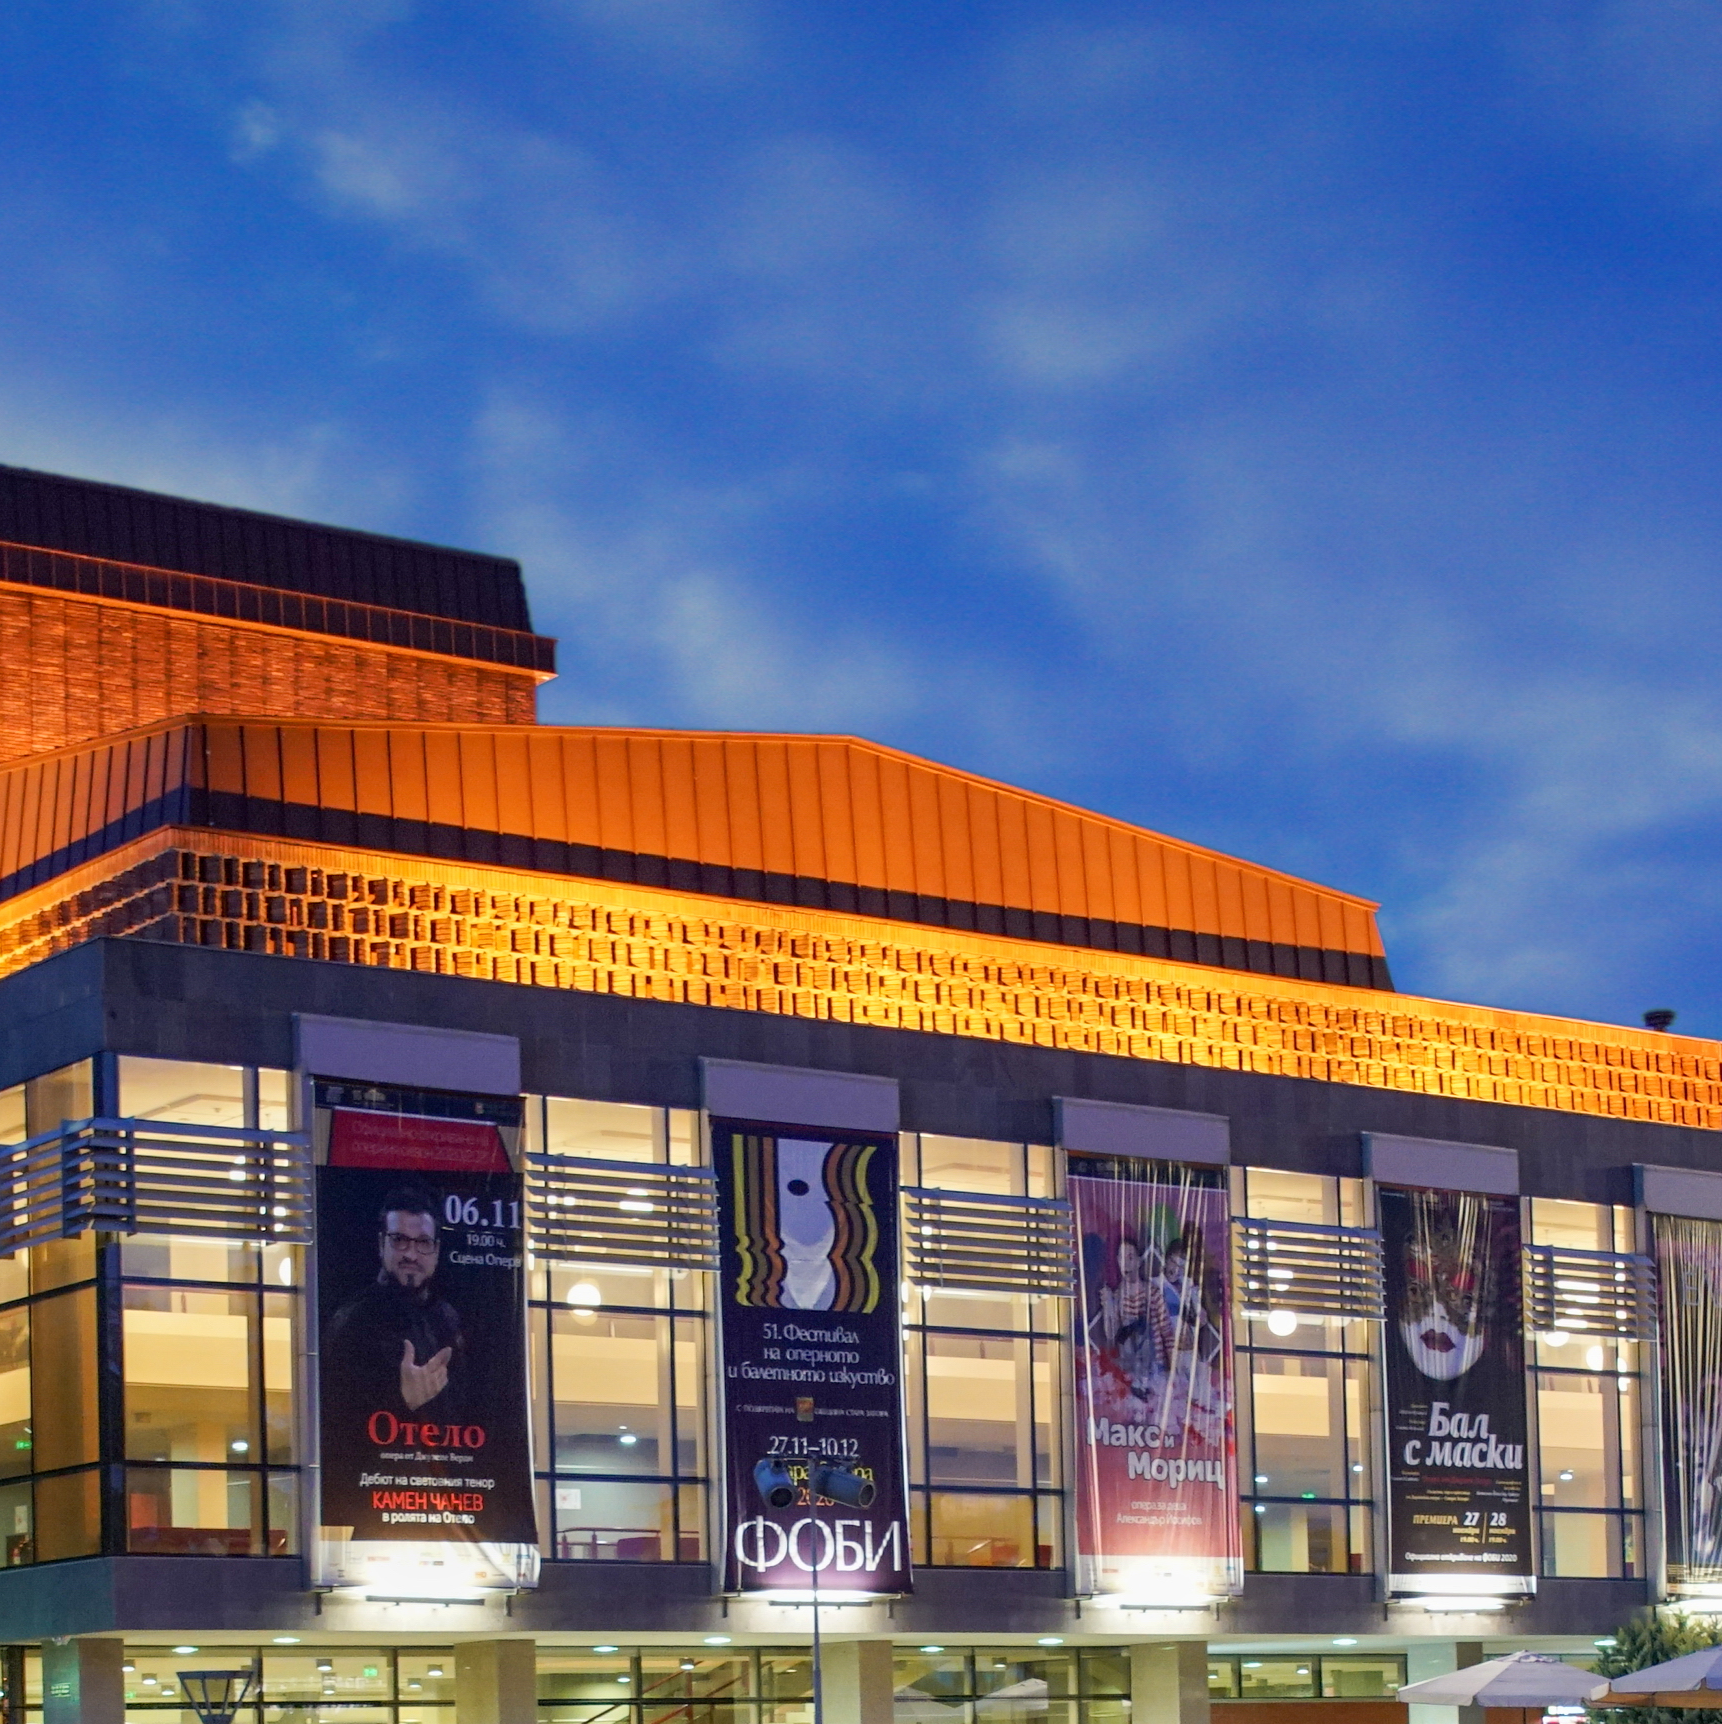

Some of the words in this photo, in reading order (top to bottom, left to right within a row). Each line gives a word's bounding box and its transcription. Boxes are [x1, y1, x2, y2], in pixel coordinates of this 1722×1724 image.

[445, 1194, 521, 1229] 06.11
[467, 1234, 495, 1247] 19.00
[450, 1251, 484, 1266] Сцена
[763, 1323, 782, 1340] 51.
[783, 1323, 859, 1344] Фестивал
[764, 1347, 781, 1360] на
[786, 1348, 859, 1367] оперното
[728, 1365, 737, 1378] и
[741, 1361, 825, 1382] балетното
[829, 1366, 895, 1389] изкуство
[368, 1410, 486, 1448] Отело
[1087, 1416, 1161, 1448] Макс
[1164, 1434, 1174, 1448] и
[1428, 1401, 1490, 1440] Бал
[1403, 1440, 1421, 1465] с
[1425, 1434, 1523, 1470] маски
[360, 1473, 393, 1487] Дебют
[395, 1475, 408, 1486] на
[409, 1475, 462, 1487] световния
[465, 1477, 495, 1490] тенор
[1128, 1451, 1225, 1490] Мориц
[372, 1491, 427, 1509] КАМЕН
[429, 1492, 483, 1511] ЧАНЕВ
[382, 1512, 390, 1522] в
[391, 1512, 427, 1524] ролята
[428, 1513, 441, 1523] на
[442, 1511, 475, 1524] Отело
[1463, 1511, 1480, 1526] 27
[1489, 1512, 1507, 1526] 28
[735, 1515, 902, 1572] ФОБИ
